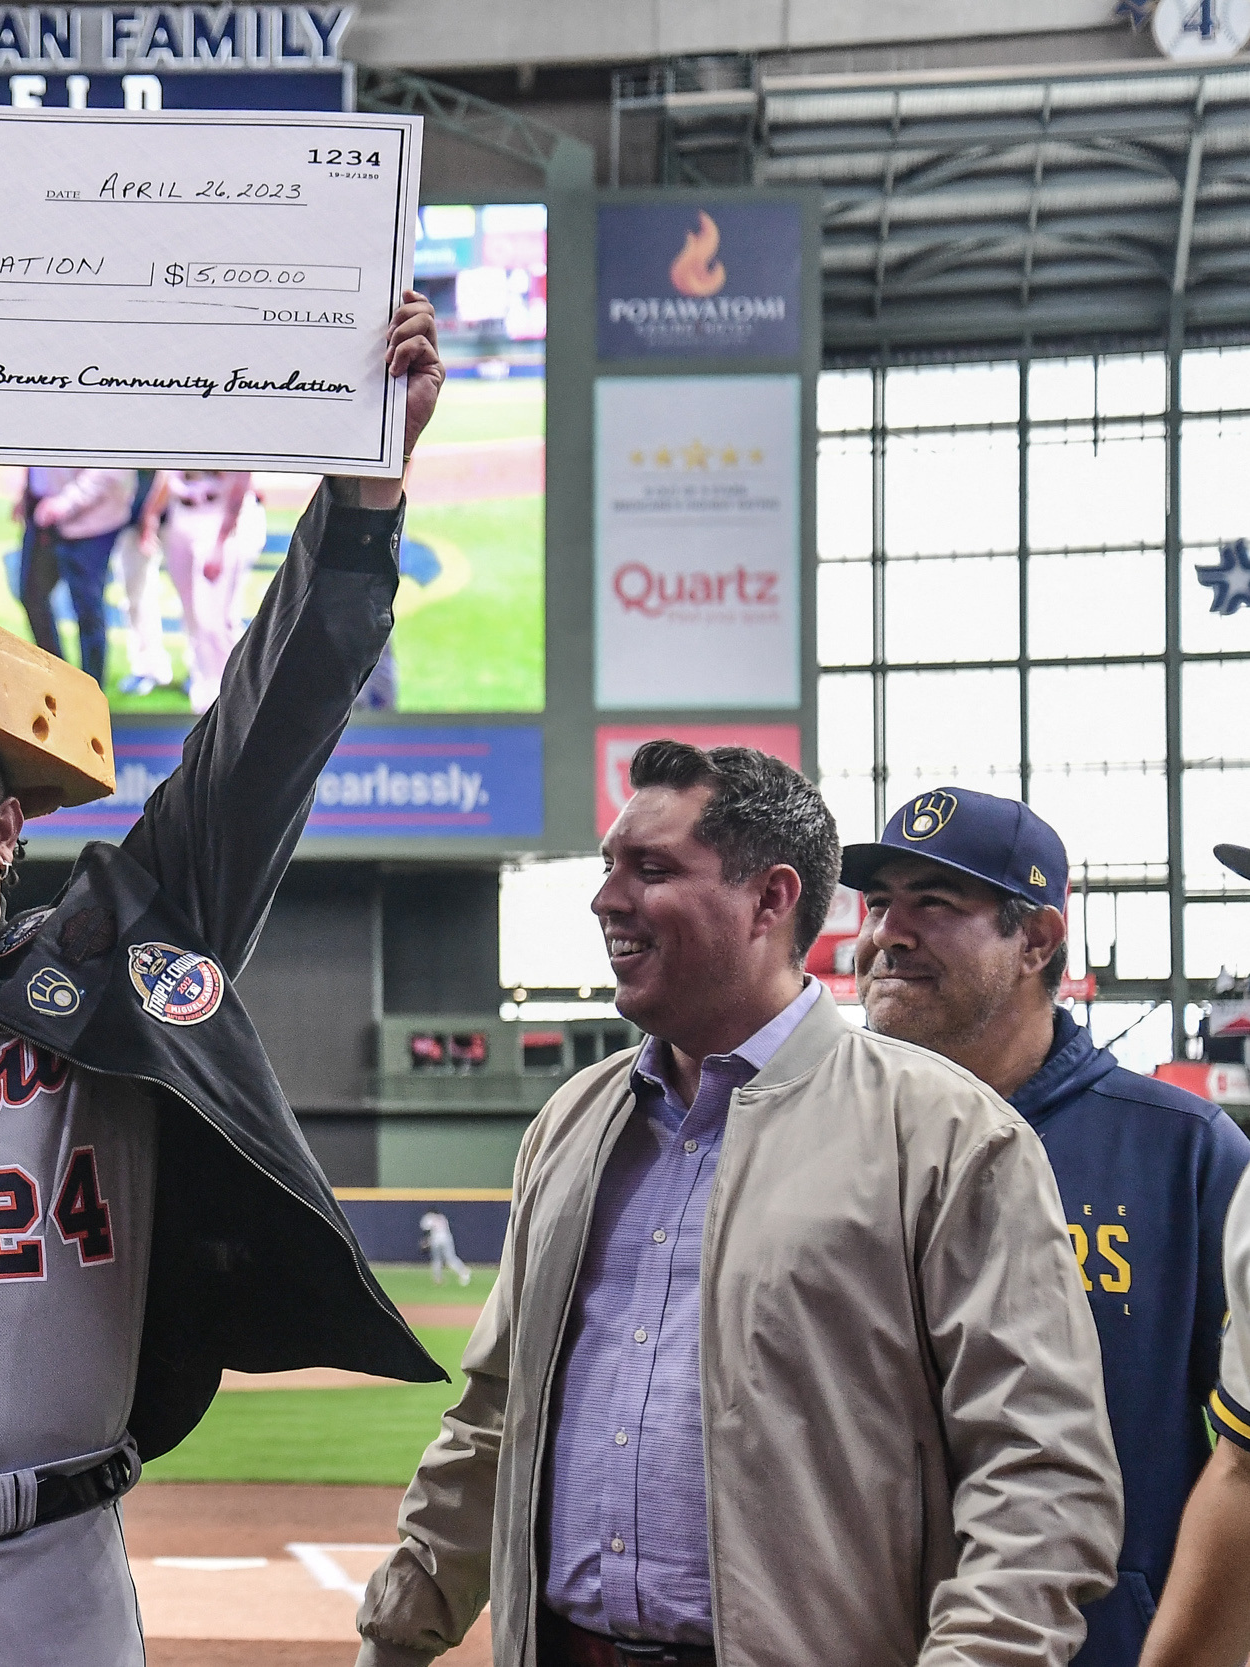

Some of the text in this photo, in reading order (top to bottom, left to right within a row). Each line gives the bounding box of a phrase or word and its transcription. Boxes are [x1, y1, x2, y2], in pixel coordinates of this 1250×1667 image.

[100, 2, 353, 69] FAMILY
[1180, 0, 1219, 44] 4
[307, 148, 382, 167] 1234
[45, 189, 82, 200] DATE
[98, 171, 183, 200] APRIL
[193, 265, 306, 286] 5,000.00
[261, 308, 356, 326] DOLLARS
[609, 296, 787, 323] POTAWATOMI
[77, 365, 219, 398] Community
[222, 366, 357, 395] Foundation
[612, 560, 779, 621] Quartz
[318, 761, 491, 814] earlessly.
[149, 972, 178, 1014] TRIPLE
[176, 975, 194, 996] 2012
[170, 1000, 204, 1014] MIGUEL
